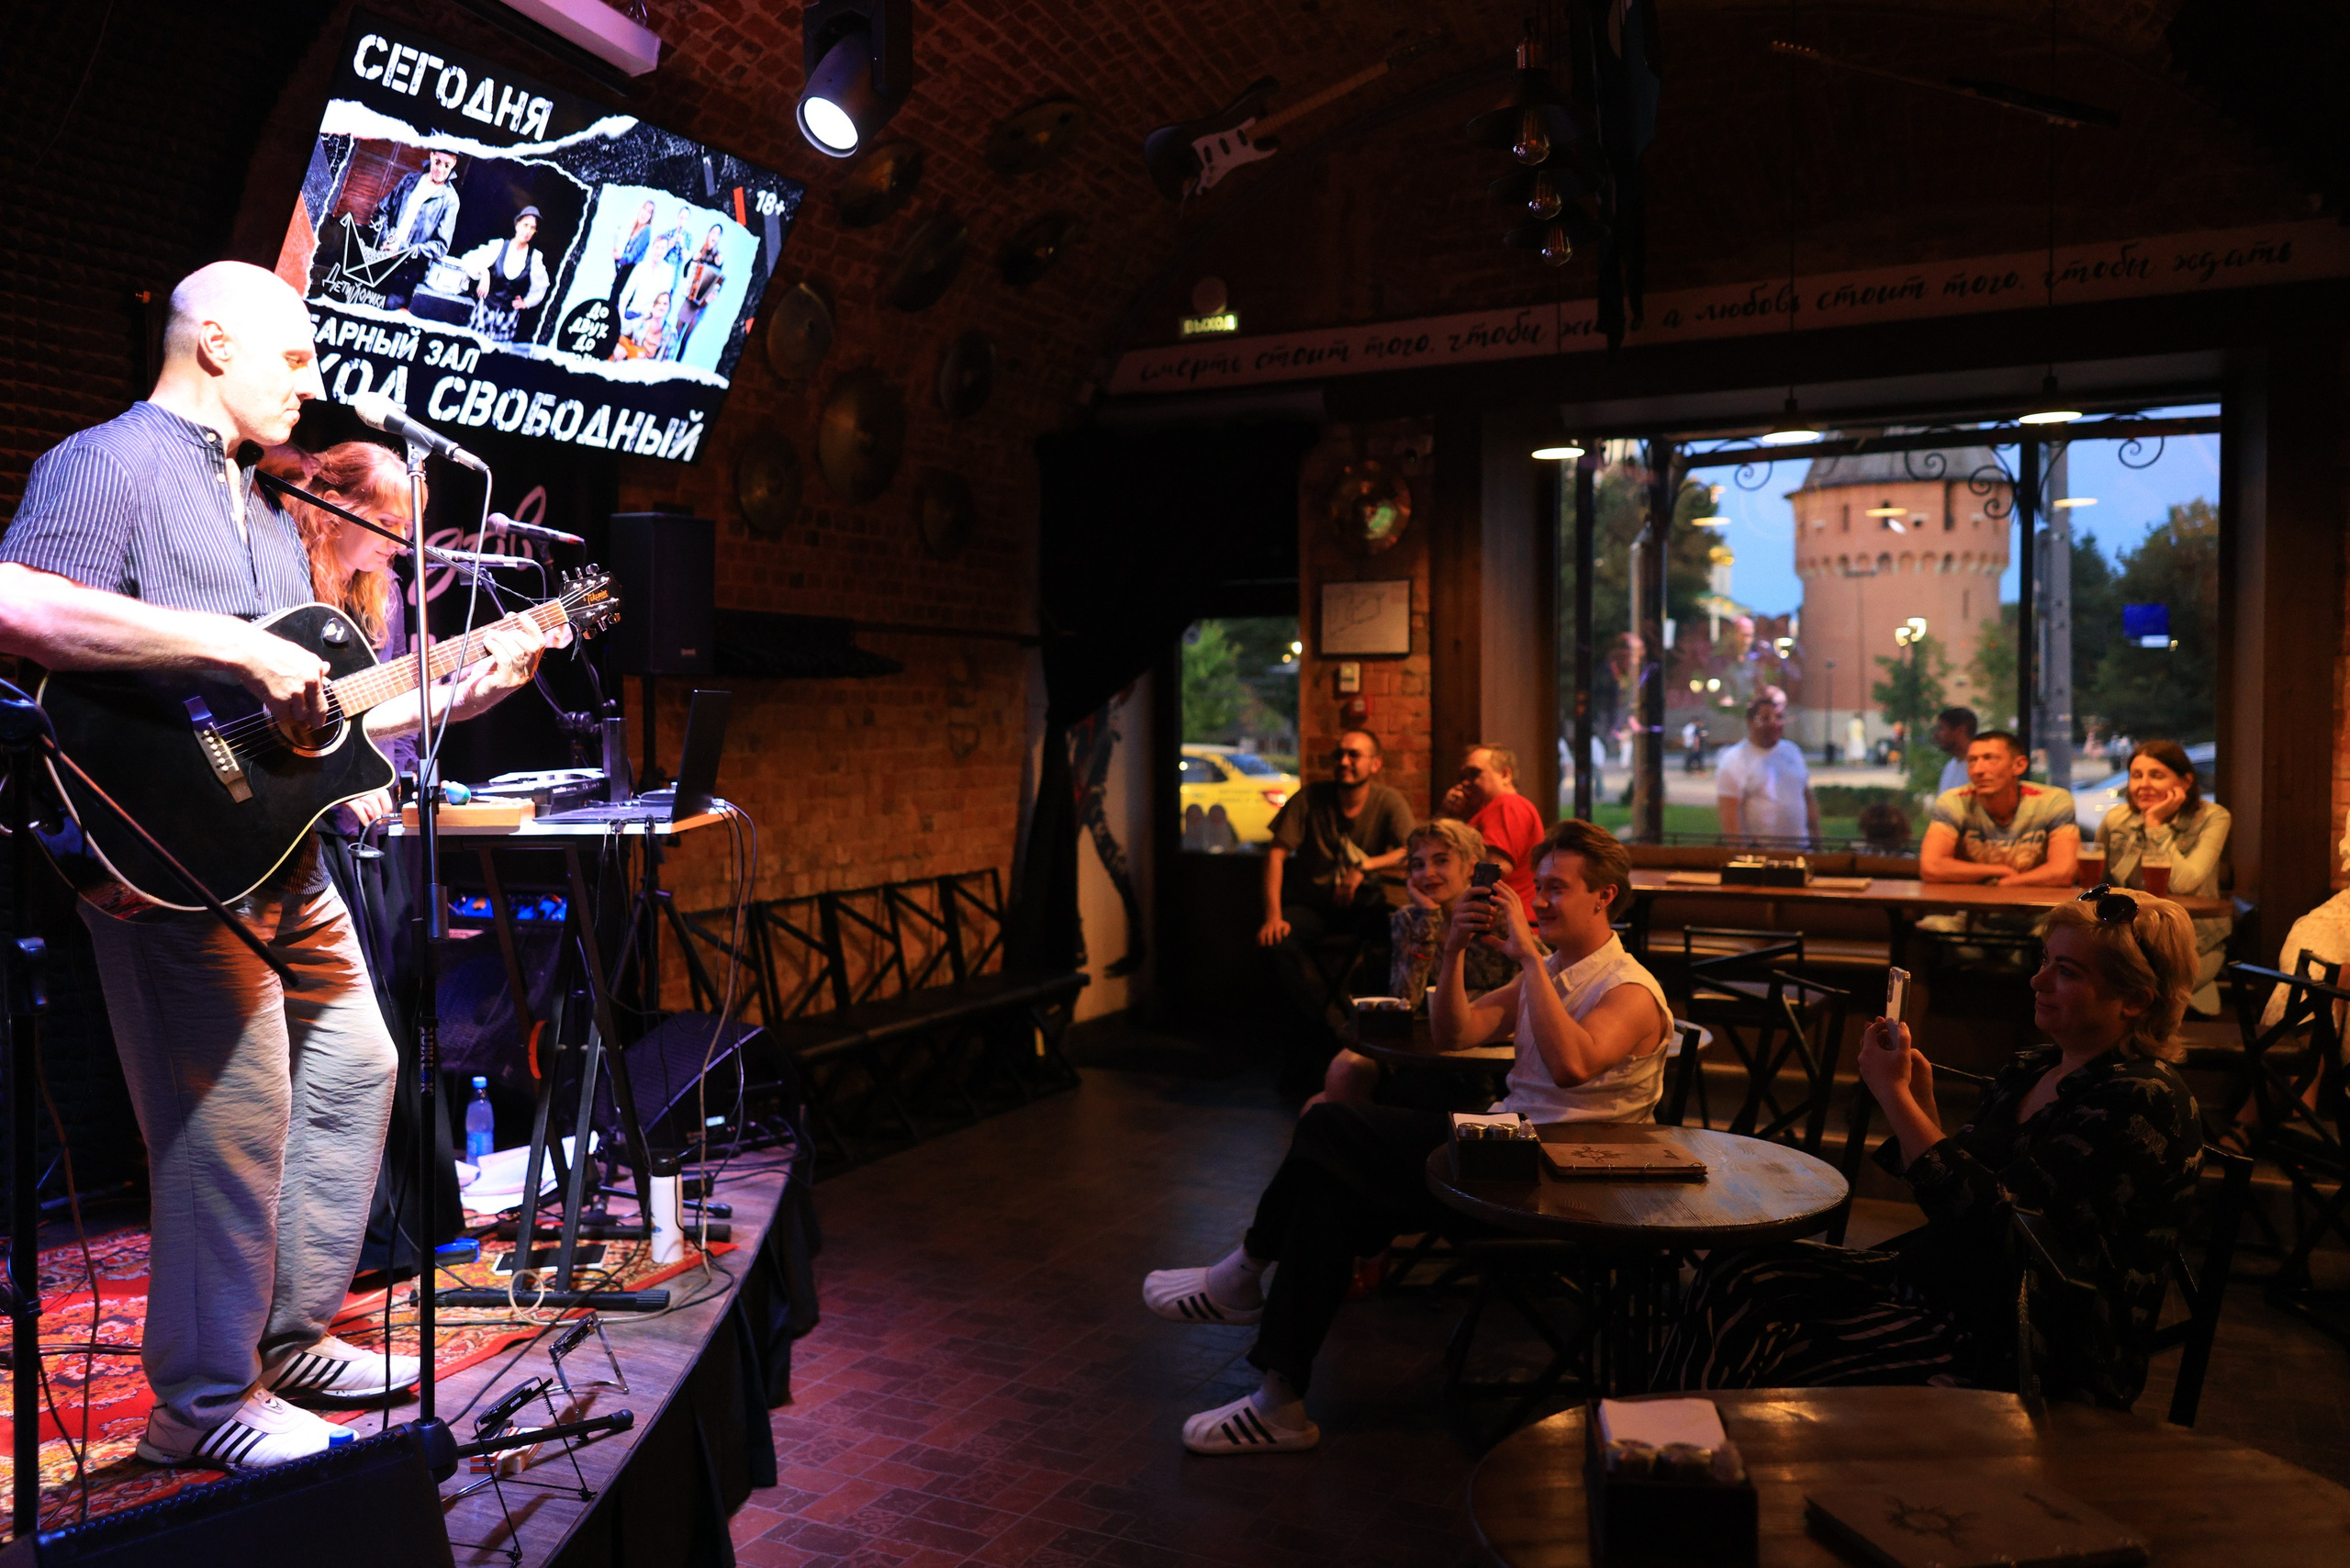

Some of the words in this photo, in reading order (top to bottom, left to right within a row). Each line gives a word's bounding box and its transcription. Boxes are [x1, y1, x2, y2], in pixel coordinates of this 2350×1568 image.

[353, 34, 554, 141] СЕГОДНЯ
[755, 190, 786, 217] 18+
[423, 340, 481, 374] ЗАЛ
[1255, 340, 1349, 367] стоит
[1817, 275, 1928, 310] стоит
[428, 375, 704, 462] СВОБОДНЫЙ
